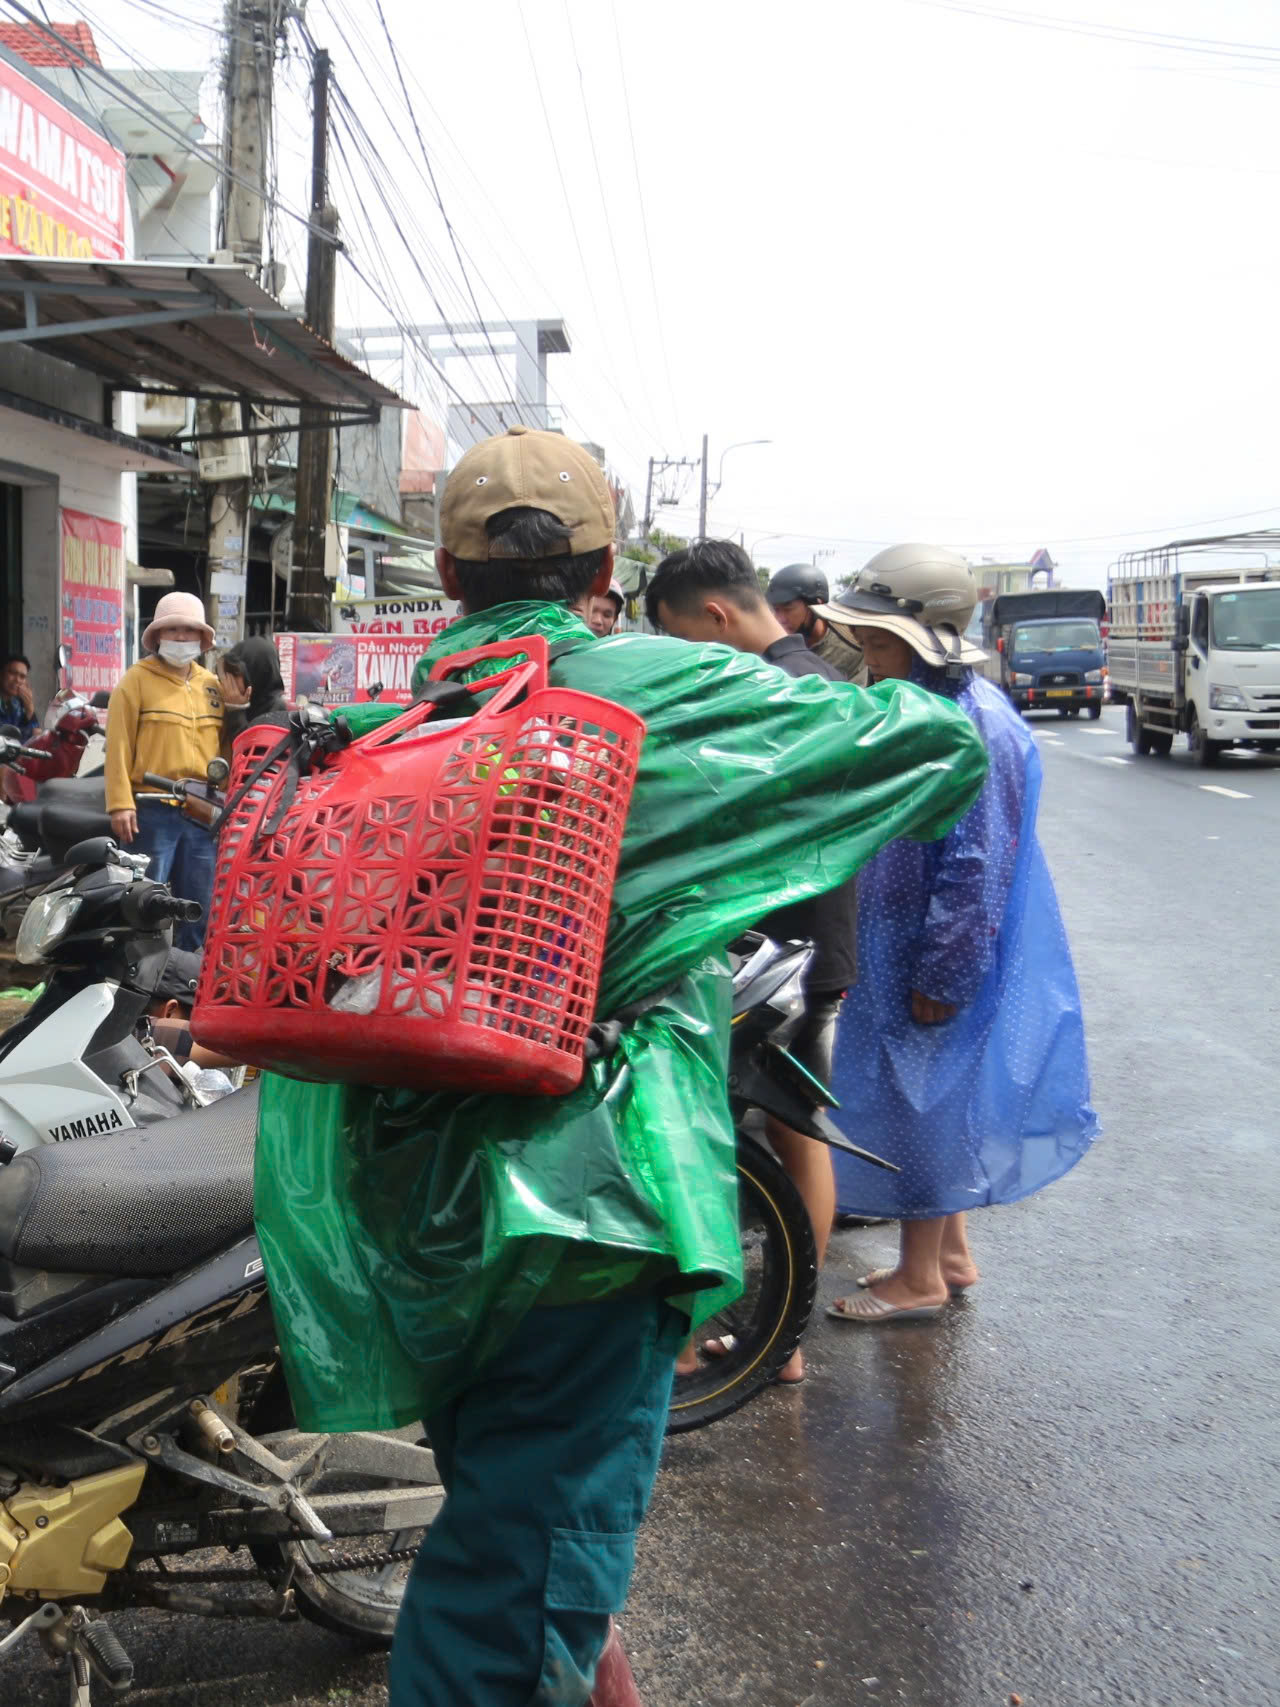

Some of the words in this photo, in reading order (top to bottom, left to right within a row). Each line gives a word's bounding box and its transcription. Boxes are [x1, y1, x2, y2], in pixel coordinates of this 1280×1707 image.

[375, 600, 442, 615] HONDA
[389, 642, 424, 653] Nhớt
[48, 1109, 123, 1142] YAMAHA
